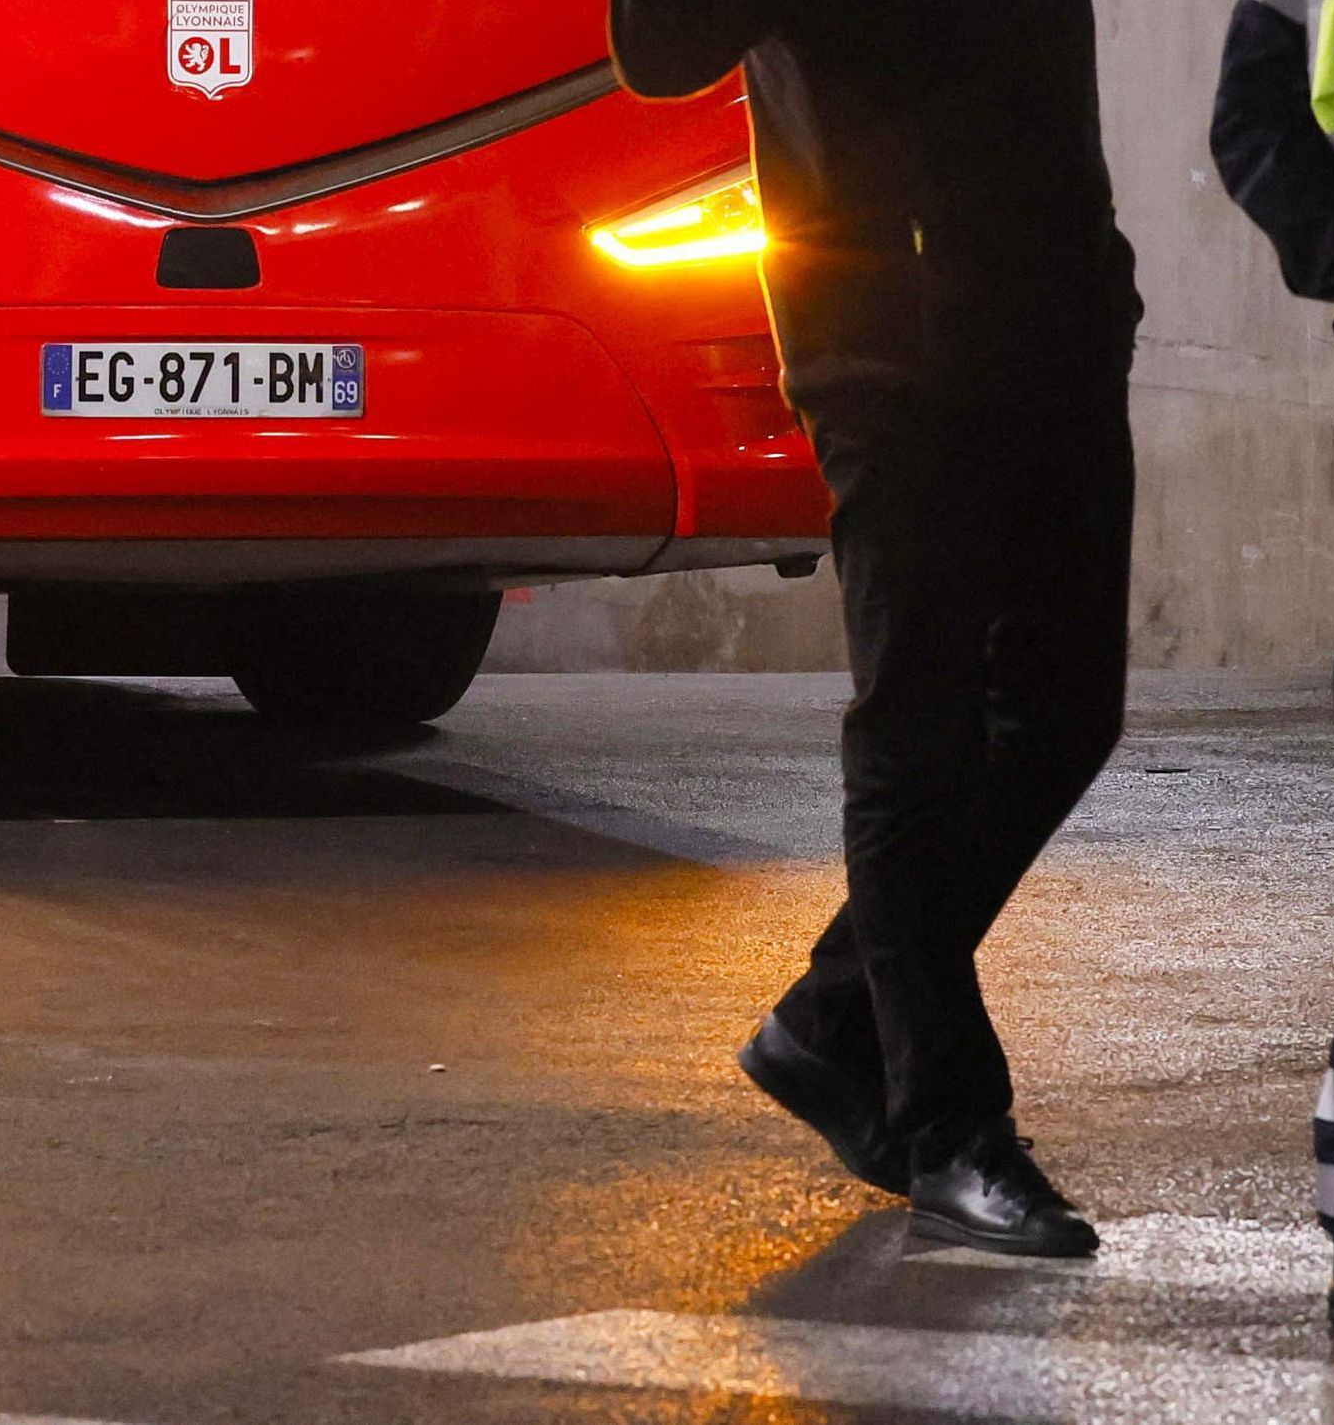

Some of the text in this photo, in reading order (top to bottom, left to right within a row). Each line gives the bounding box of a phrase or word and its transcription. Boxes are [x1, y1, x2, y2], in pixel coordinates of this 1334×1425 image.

[176, 4, 244, 14] OLYMPIQUE
[176, 16, 244, 27] LYONNAIS
[178, 36, 241, 75] OL
[53, 351, 358, 404] F EG-871-BM 69
